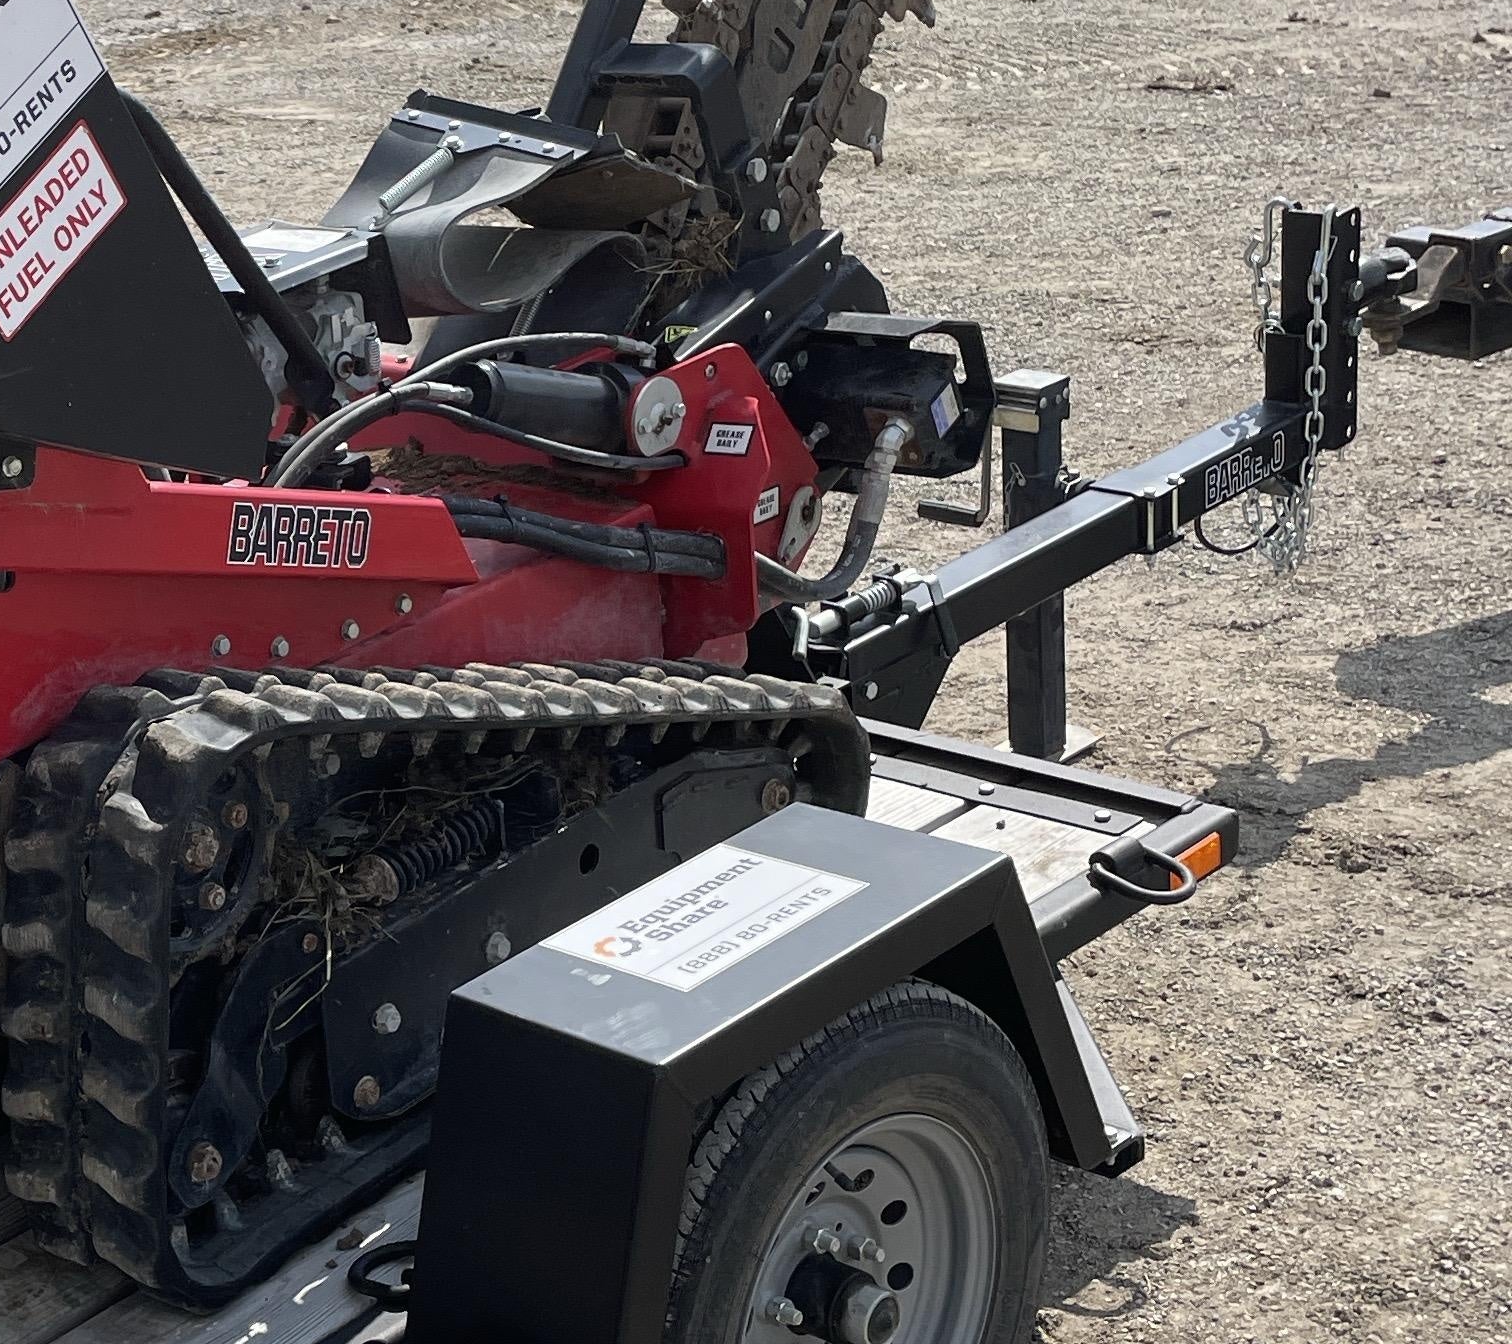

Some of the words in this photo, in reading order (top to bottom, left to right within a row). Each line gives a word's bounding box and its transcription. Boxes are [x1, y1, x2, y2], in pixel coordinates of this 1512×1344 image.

[54, 178, 110, 253] ONLY
[226, 502, 372, 568] BARRETO
[617, 856, 763, 934] Equipment
[644, 896, 729, 942] Share
[677, 941, 741, 974] (888)
[735, 886, 833, 941] 80-RENTS
